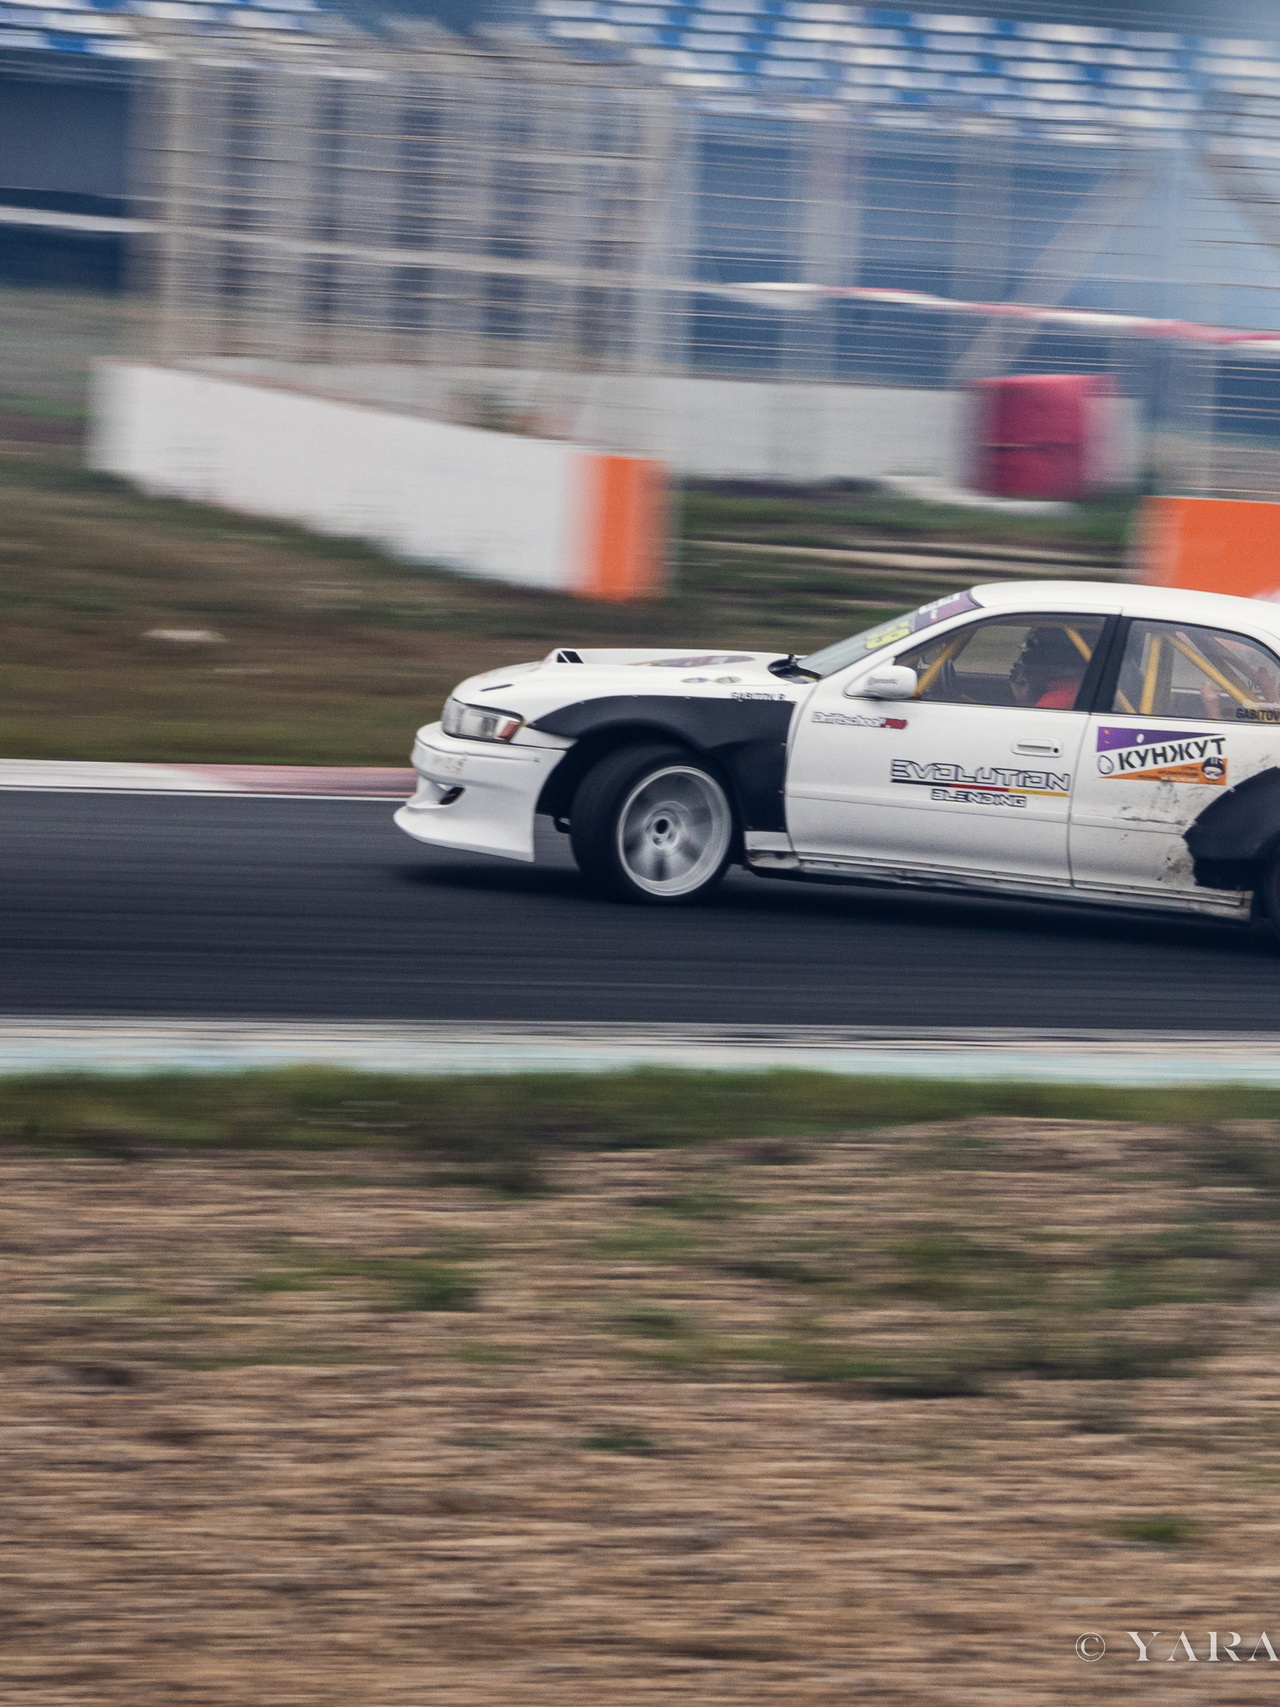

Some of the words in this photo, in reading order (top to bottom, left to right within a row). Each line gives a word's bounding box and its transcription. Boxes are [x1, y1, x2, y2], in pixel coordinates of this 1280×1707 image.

[1236, 708, 1280, 721] GABITOV
[1118, 737, 1227, 770] КУНЖУТ
[891, 758, 1071, 792] EVOLUTION
[931, 788, 1027, 808] BLENDING
